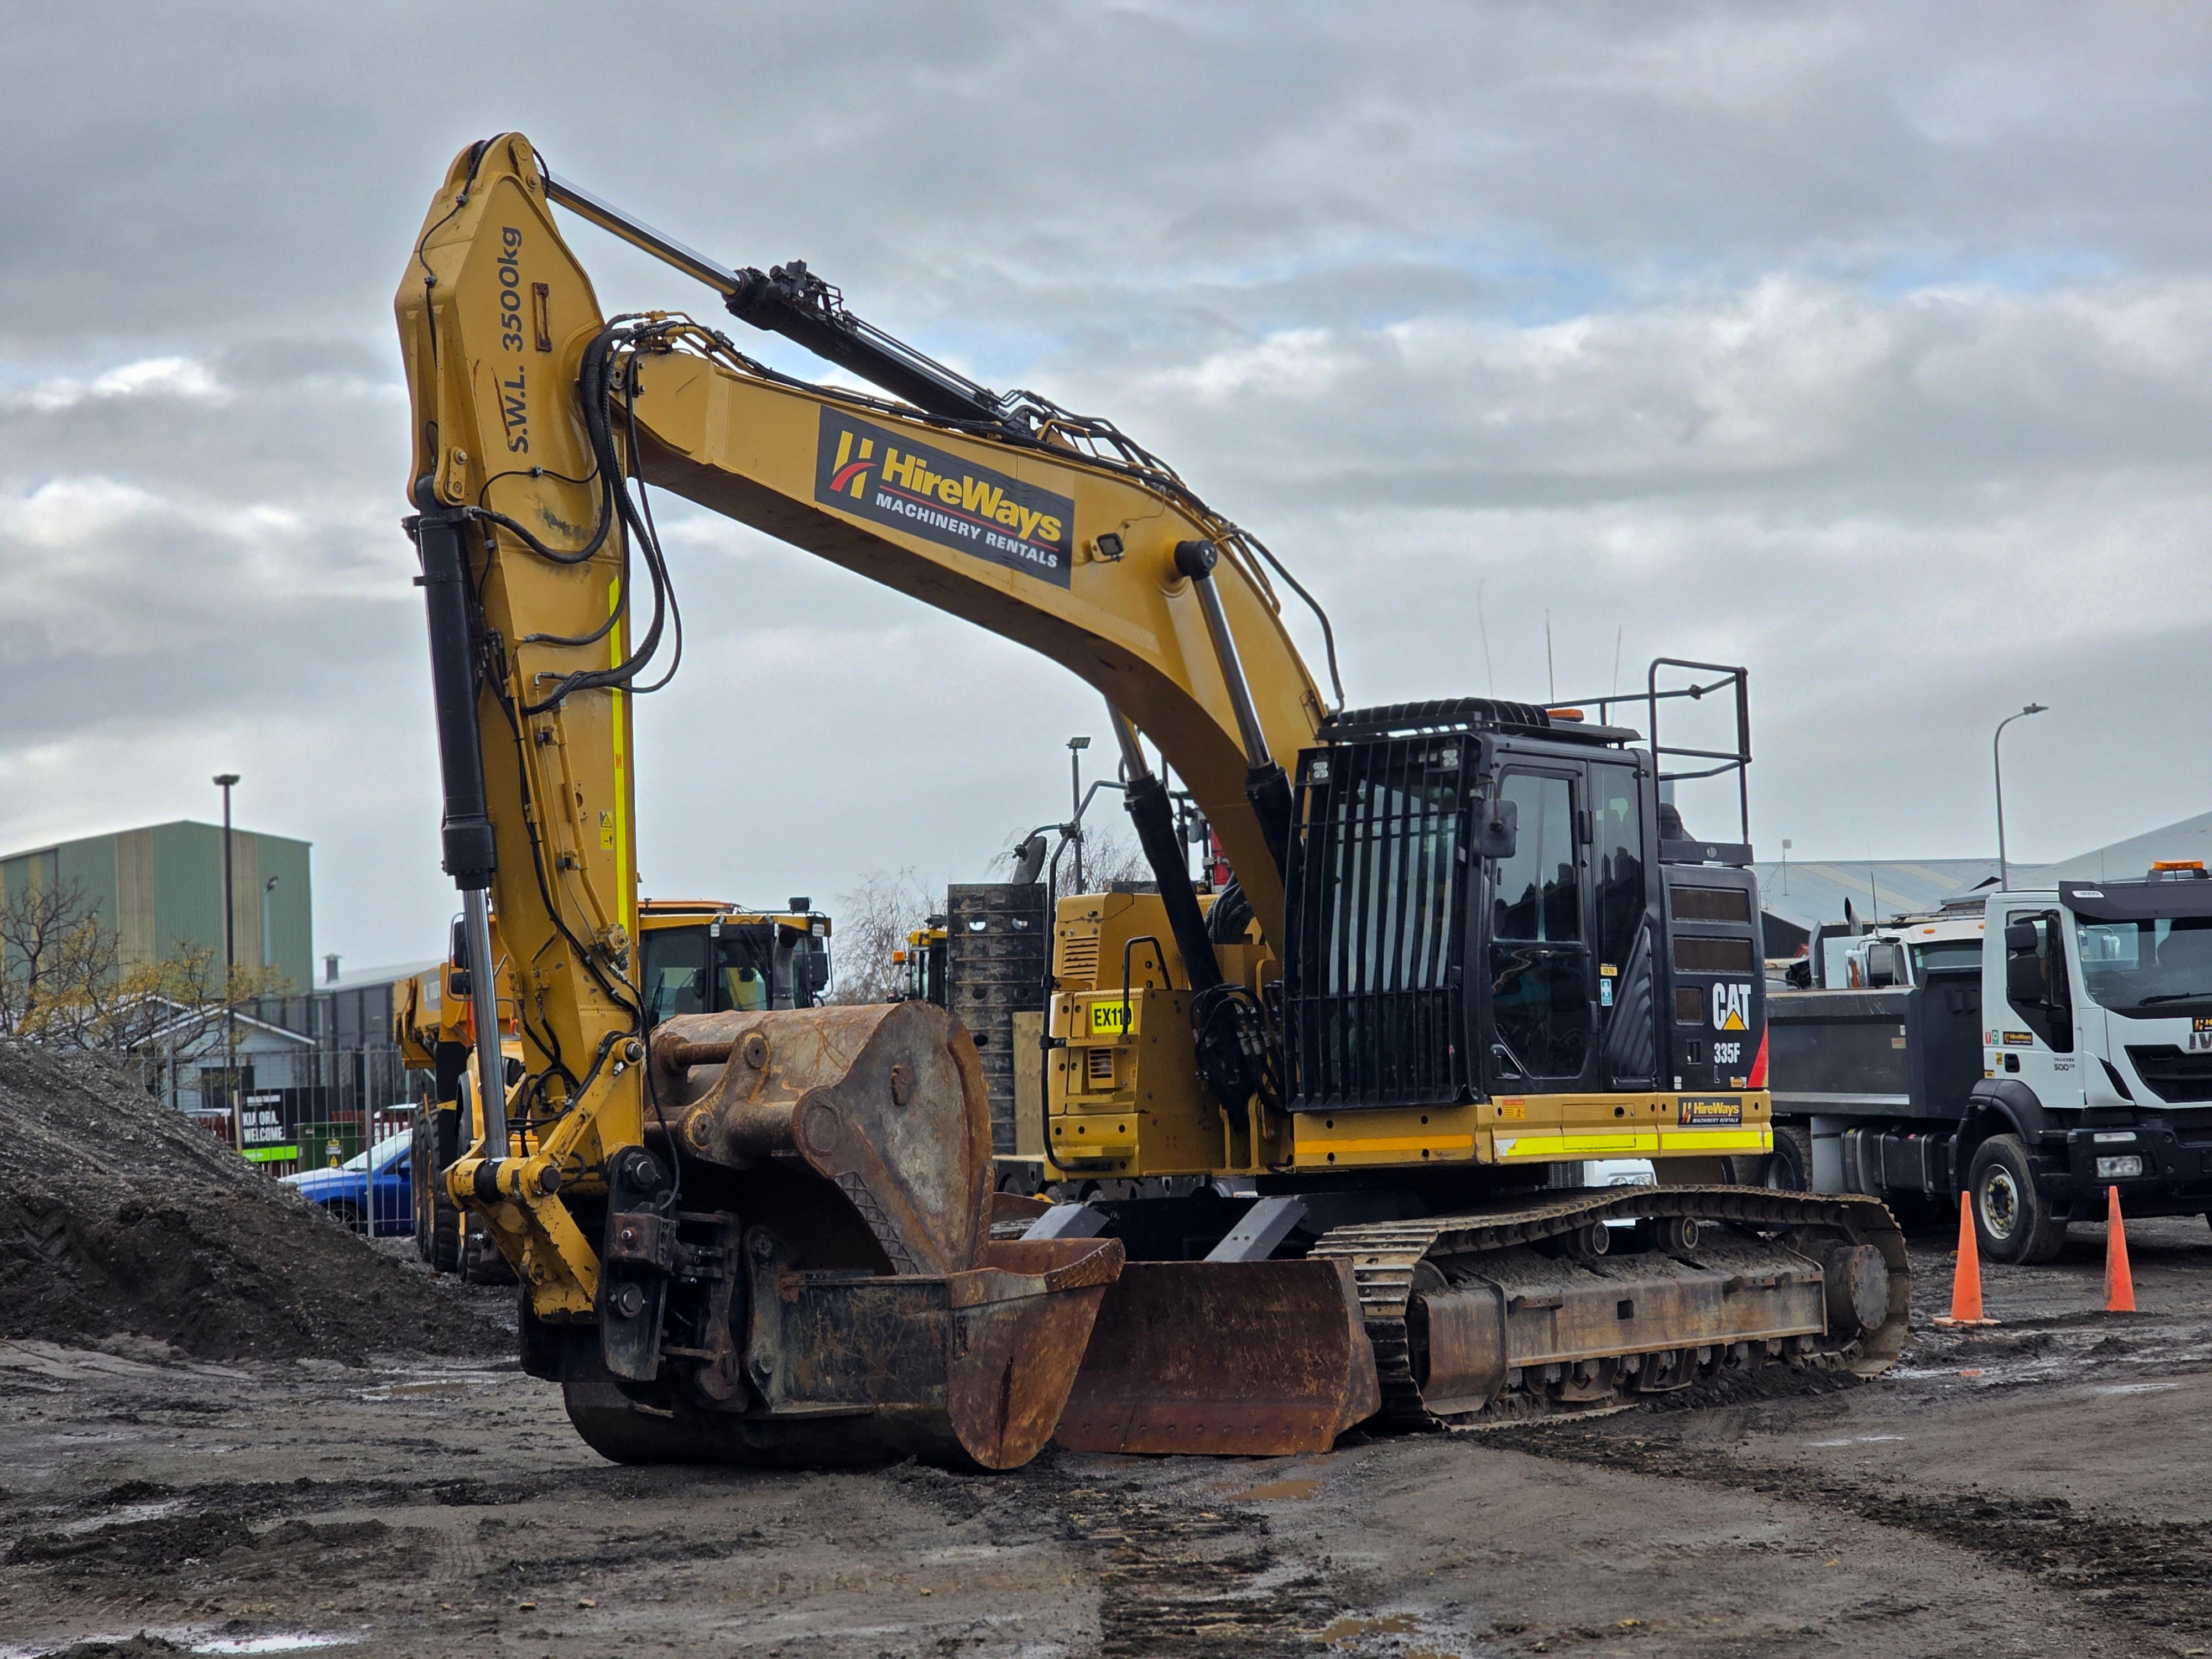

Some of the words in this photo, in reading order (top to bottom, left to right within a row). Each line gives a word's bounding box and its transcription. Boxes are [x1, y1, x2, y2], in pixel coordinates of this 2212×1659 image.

[497, 227, 524, 352] 3500kg
[504, 366, 529, 455] S.W.L.
[881, 447, 1062, 542] HireWays
[876, 493, 982, 540] MACHINERY
[986, 533, 1058, 568] RENTALS
[1712, 982, 1752, 1031] CAT
[1713, 1042, 1741, 1065] 335F
[1714, 1065, 1721, 1084] L
[2054, 1063, 2069, 1071] 500
[242, 1112, 257, 1126] KIA
[259, 1110, 279, 1125] ORA.
[1693, 1102, 1740, 1117] HireWays
[243, 1126, 286, 1144] WELCOME.
